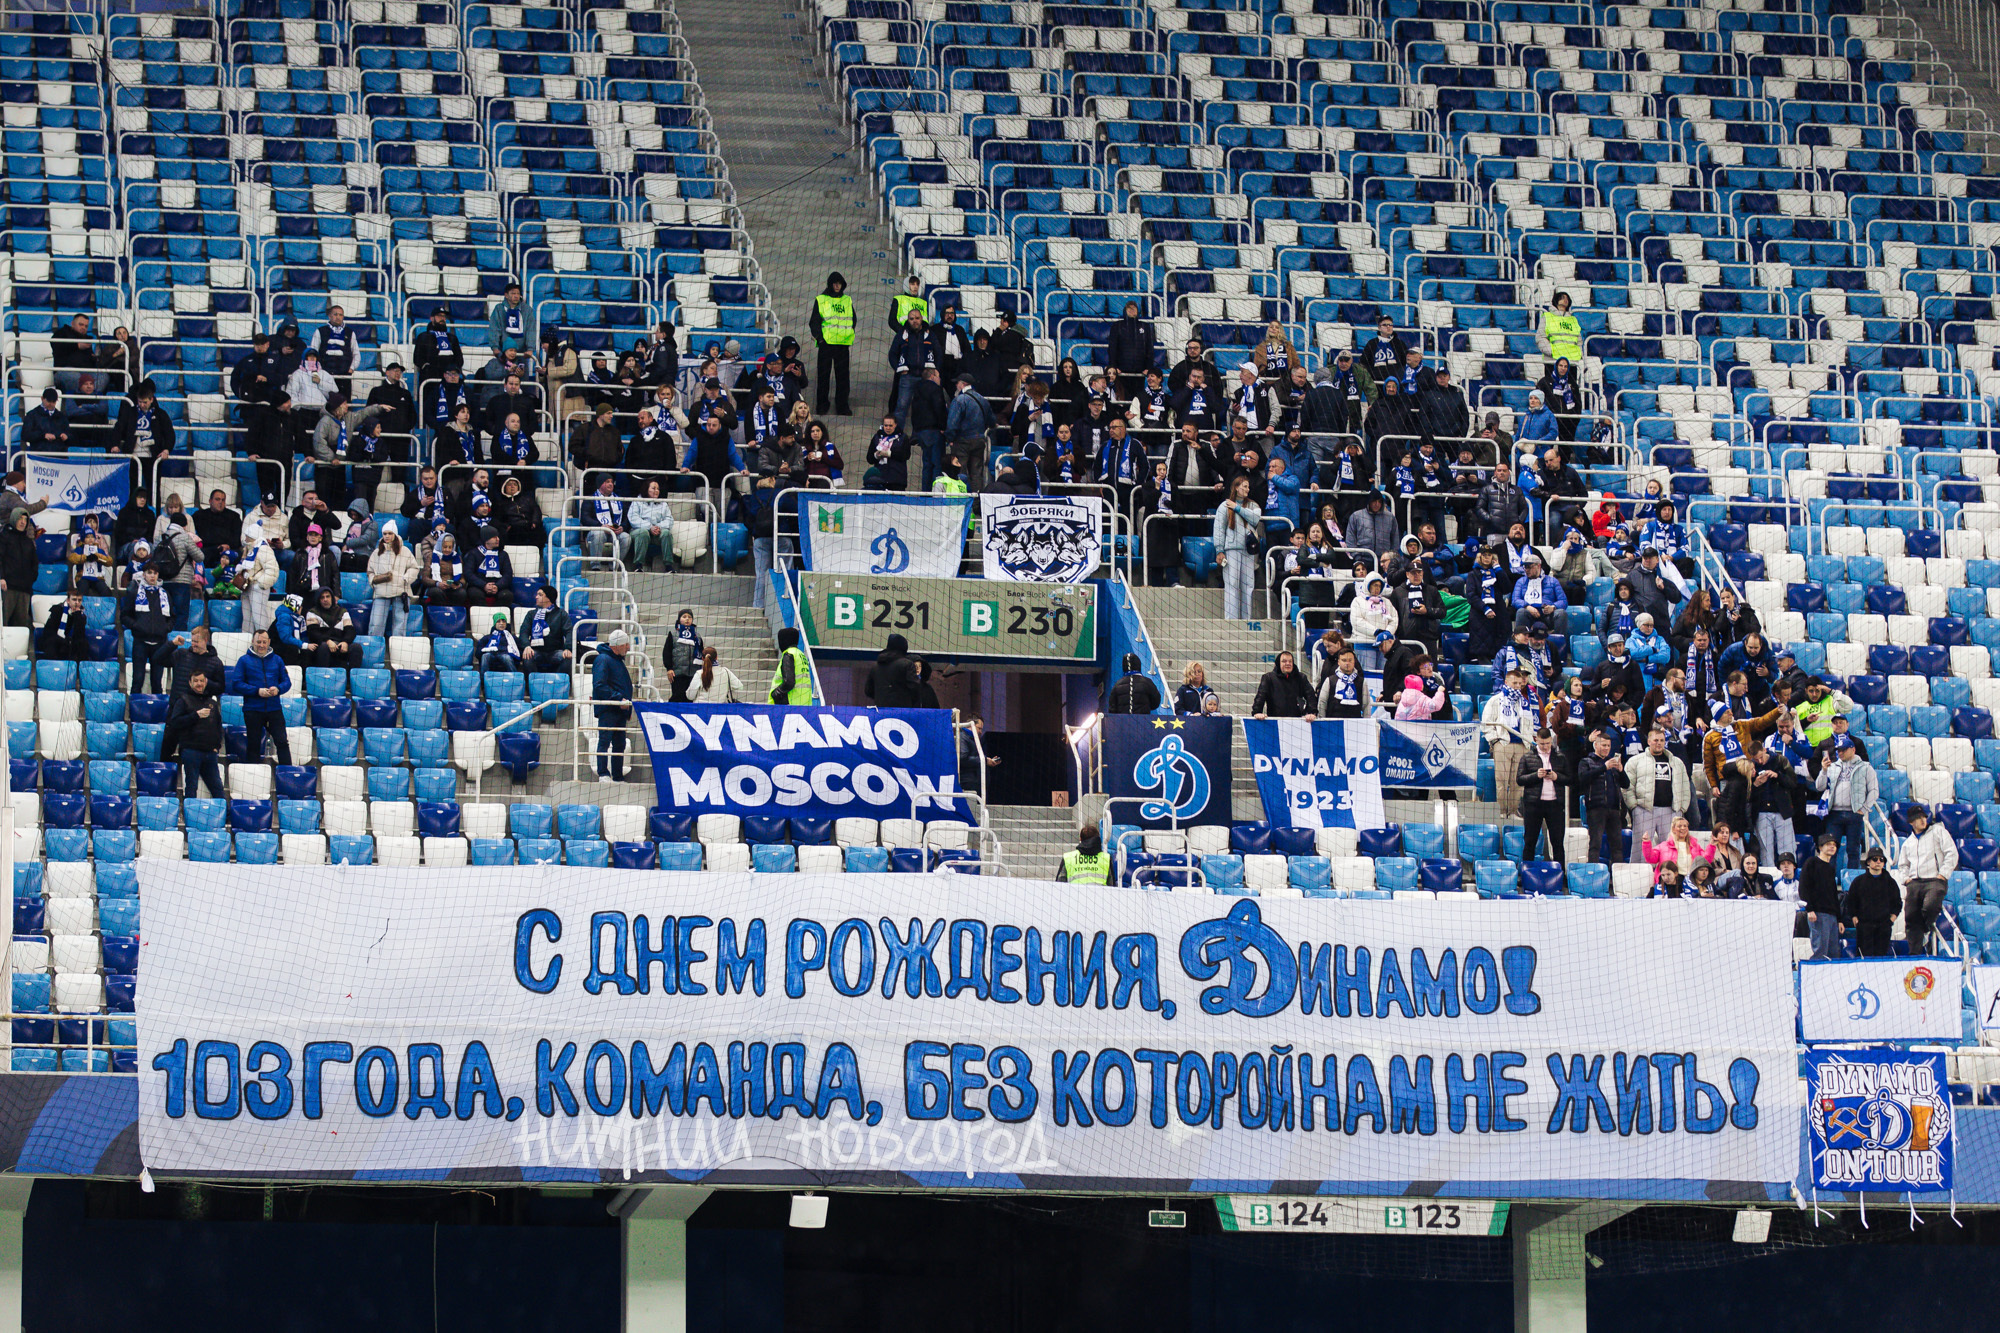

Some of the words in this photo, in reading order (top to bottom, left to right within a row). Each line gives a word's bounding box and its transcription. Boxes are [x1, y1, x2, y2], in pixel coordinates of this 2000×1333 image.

[33, 465, 60, 478] MOSCOW
[36, 478, 53, 486] 1923
[1009, 506, 1074, 518] ДОБРЯКИ
[871, 583, 890, 591] Блок
[871, 599, 929, 630] 231
[1007, 605, 1073, 636] 230
[1247, 621, 1262, 631] 16
[640, 711, 920, 759] DYNAMO
[1253, 754, 1380, 777] DYNAMO
[668, 762, 956, 812] MOSCOW
[1284, 789, 1354, 811] 1923
[514, 908, 563, 994] С
[583, 910, 767, 997] ДНЕМ
[785, 917, 1177, 1020] РОЖДЕНИЯ,
[152, 1038, 294, 1121] 103
[302, 1040, 525, 1122] ГОДА,
[535, 1038, 883, 1127] КОМАНДА,
[903, 1040, 1039, 1123] БЕЗ
[1051, 1044, 1295, 1131] КОТОРОЙ
[1298, 1053, 1437, 1136] НАМ
[1445, 1050, 1528, 1134] НЕ
[1546, 1051, 1760, 1136] ЖИТЬ!
[1818, 1063, 1934, 1098] DYNAMO
[1824, 1149, 1864, 1183] ON
[1866, 1149, 1940, 1183] TOUR
[1278, 1202, 1328, 1226] 124
[1412, 1205, 1461, 1229] 123
